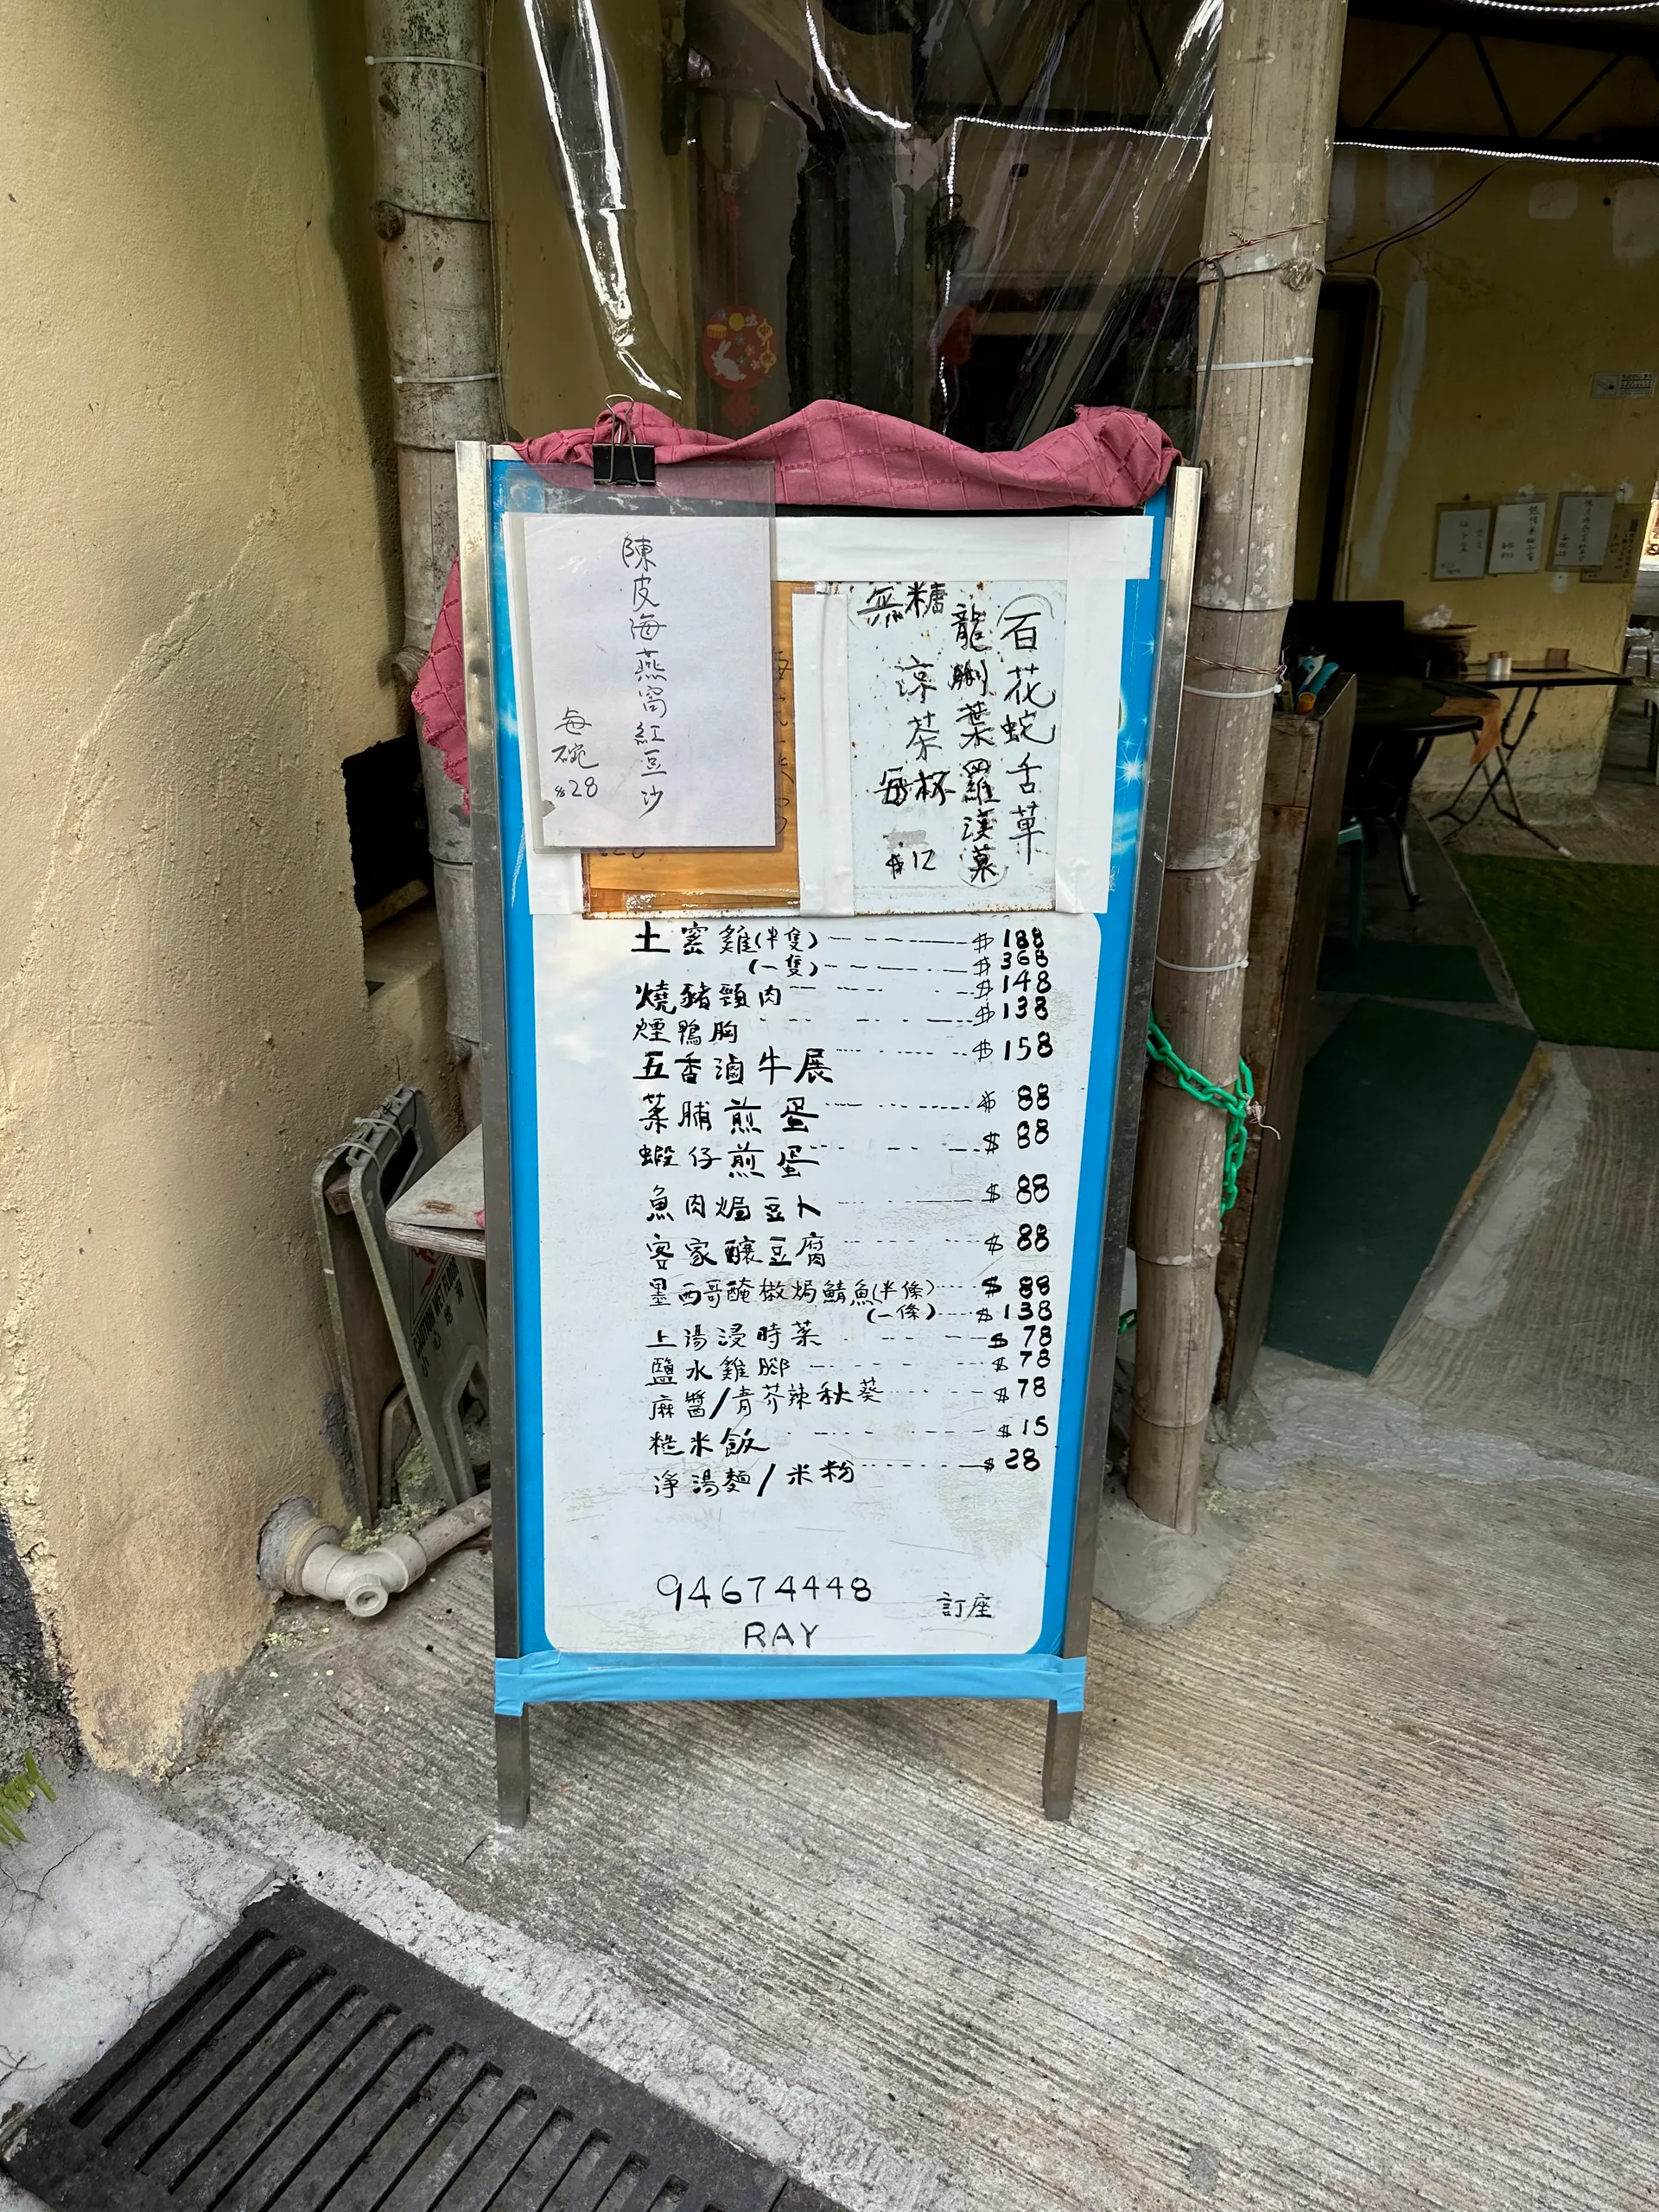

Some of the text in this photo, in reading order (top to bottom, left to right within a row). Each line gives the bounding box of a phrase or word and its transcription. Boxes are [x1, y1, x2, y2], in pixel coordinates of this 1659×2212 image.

[622, 536, 667, 817] 陳皮海燕窩紅豆沙
[552, 707, 599, 769] 每碗
[555, 777, 598, 798] $28
[972, 927, 1044, 954] $188
[636, 969, 1052, 1014] 燒豬頸肉 $148
[632, 995, 1048, 1045] 煙鴨胸 $138
[633, 1031, 1052, 1085] 五香滷牛展 $158
[639, 1083, 1049, 1134] 菜脯煎蛋 $88
[639, 1119, 1049, 1178] 蝦仔煎蛋 $88
[982, 1173, 1049, 1204] $88
[646, 1224, 1049, 1269] 客家釀豆腐 $88
[646, 1319, 1052, 1351] 上湯浸時菜 $78
[992, 1349, 1050, 1372] $78
[646, 1376, 1046, 1420] 麻醬/青芥辣秋葵 $78
[649, 1415, 1048, 1457] 糙米飯 $15
[983, 1448, 1039, 1472] $28
[657, 1574, 871, 1611] 94674448
[937, 1592, 991, 1618] 訂座
[745, 1622, 818, 1649] RAY
